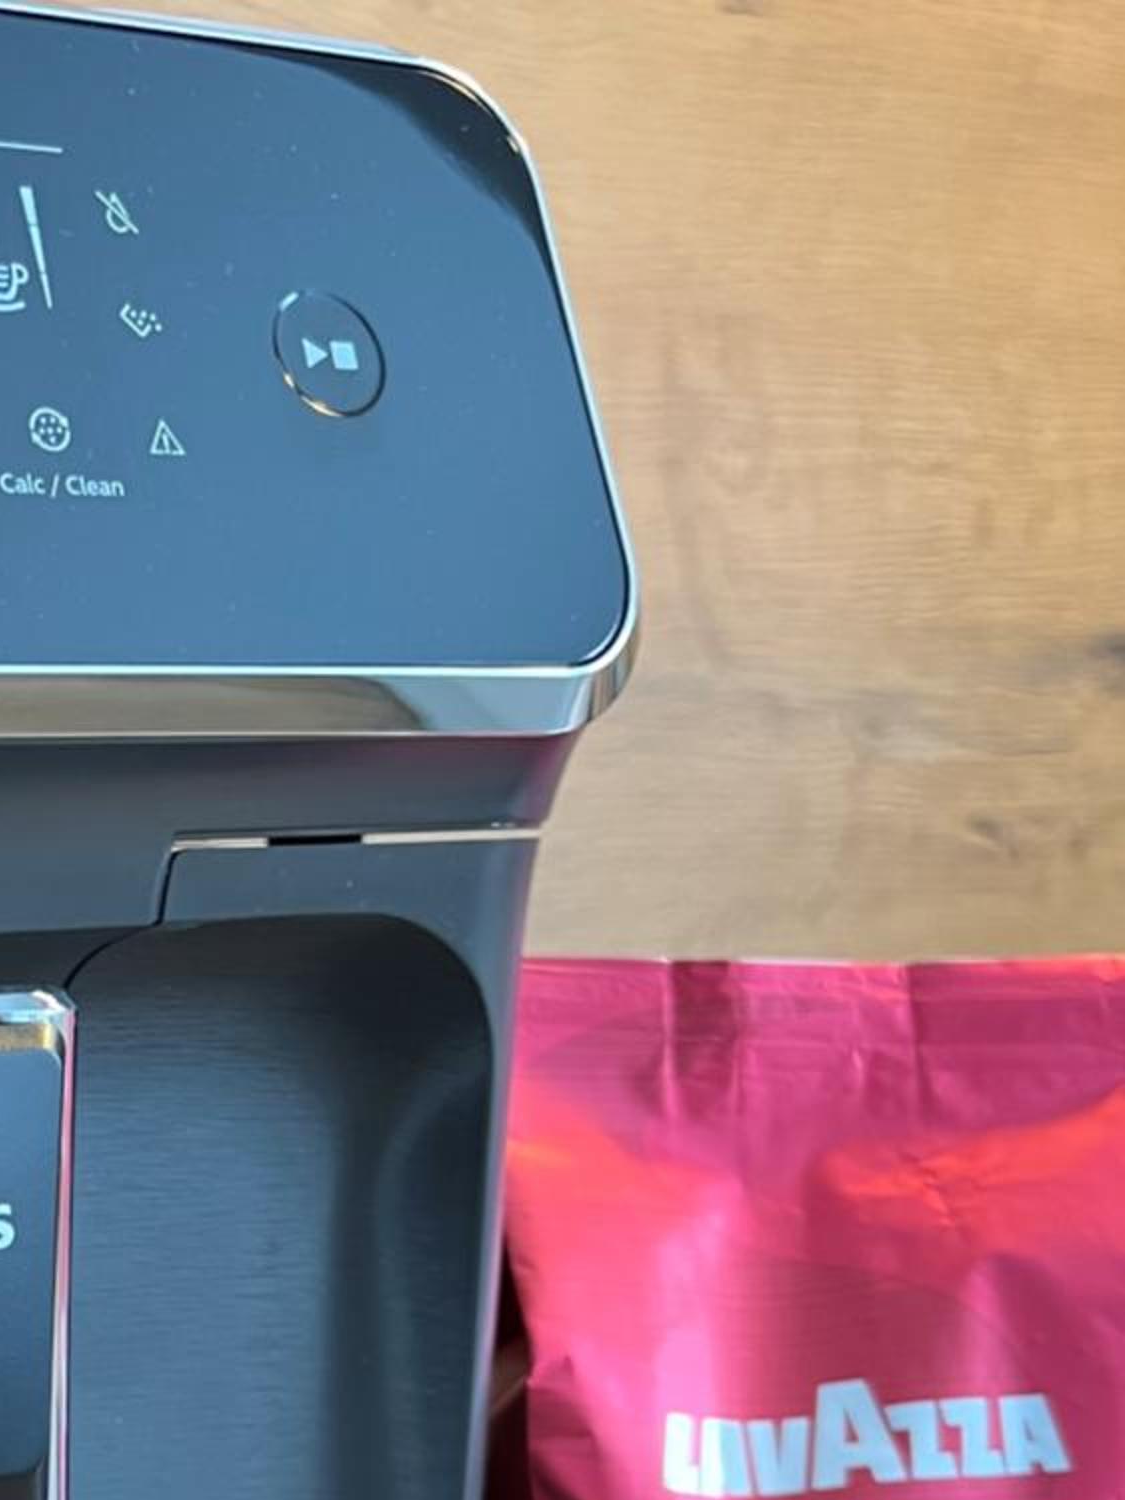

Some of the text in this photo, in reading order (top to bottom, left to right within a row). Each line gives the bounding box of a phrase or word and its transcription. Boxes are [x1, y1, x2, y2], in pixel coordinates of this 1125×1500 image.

[0, 472, 45, 496] Calc
[65, 475, 125, 497] Clean
[663, 1377, 1072, 1499] LAVAZZA
